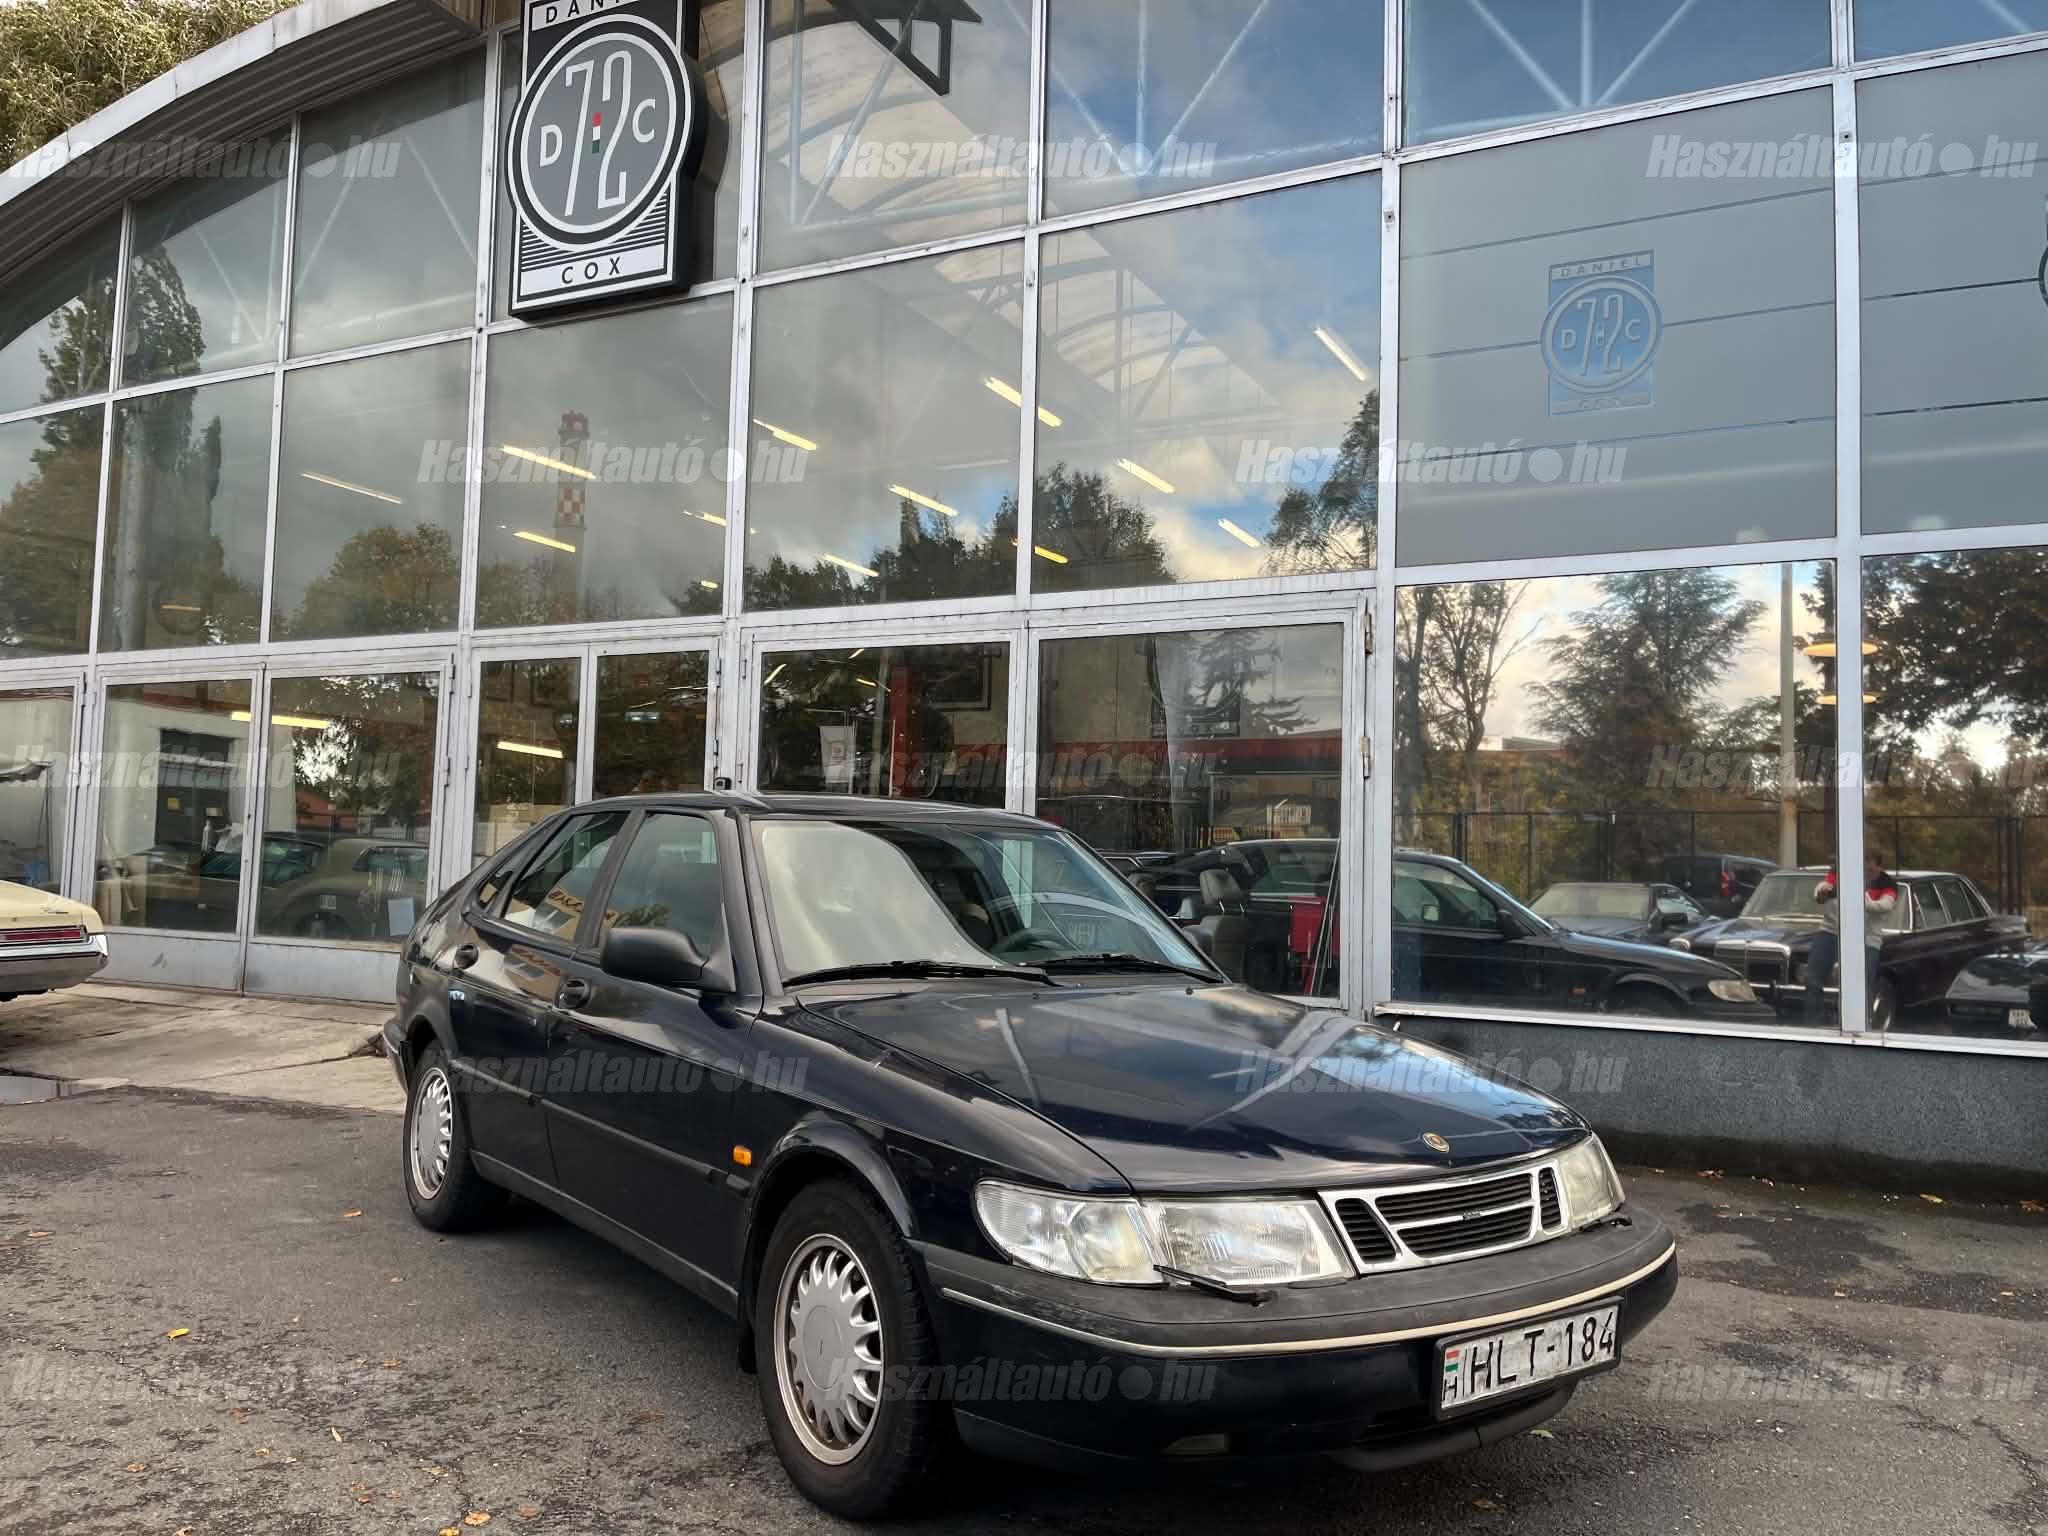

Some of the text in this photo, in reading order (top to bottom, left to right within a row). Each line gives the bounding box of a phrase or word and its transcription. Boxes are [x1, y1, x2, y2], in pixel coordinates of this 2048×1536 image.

[540, 124, 563, 168] D
[632, 99, 656, 143] C
[561, 256, 620, 284] COX
[1561, 255, 1641, 277] DANIEL
[1471, 1311, 1614, 1394] HLT-184
